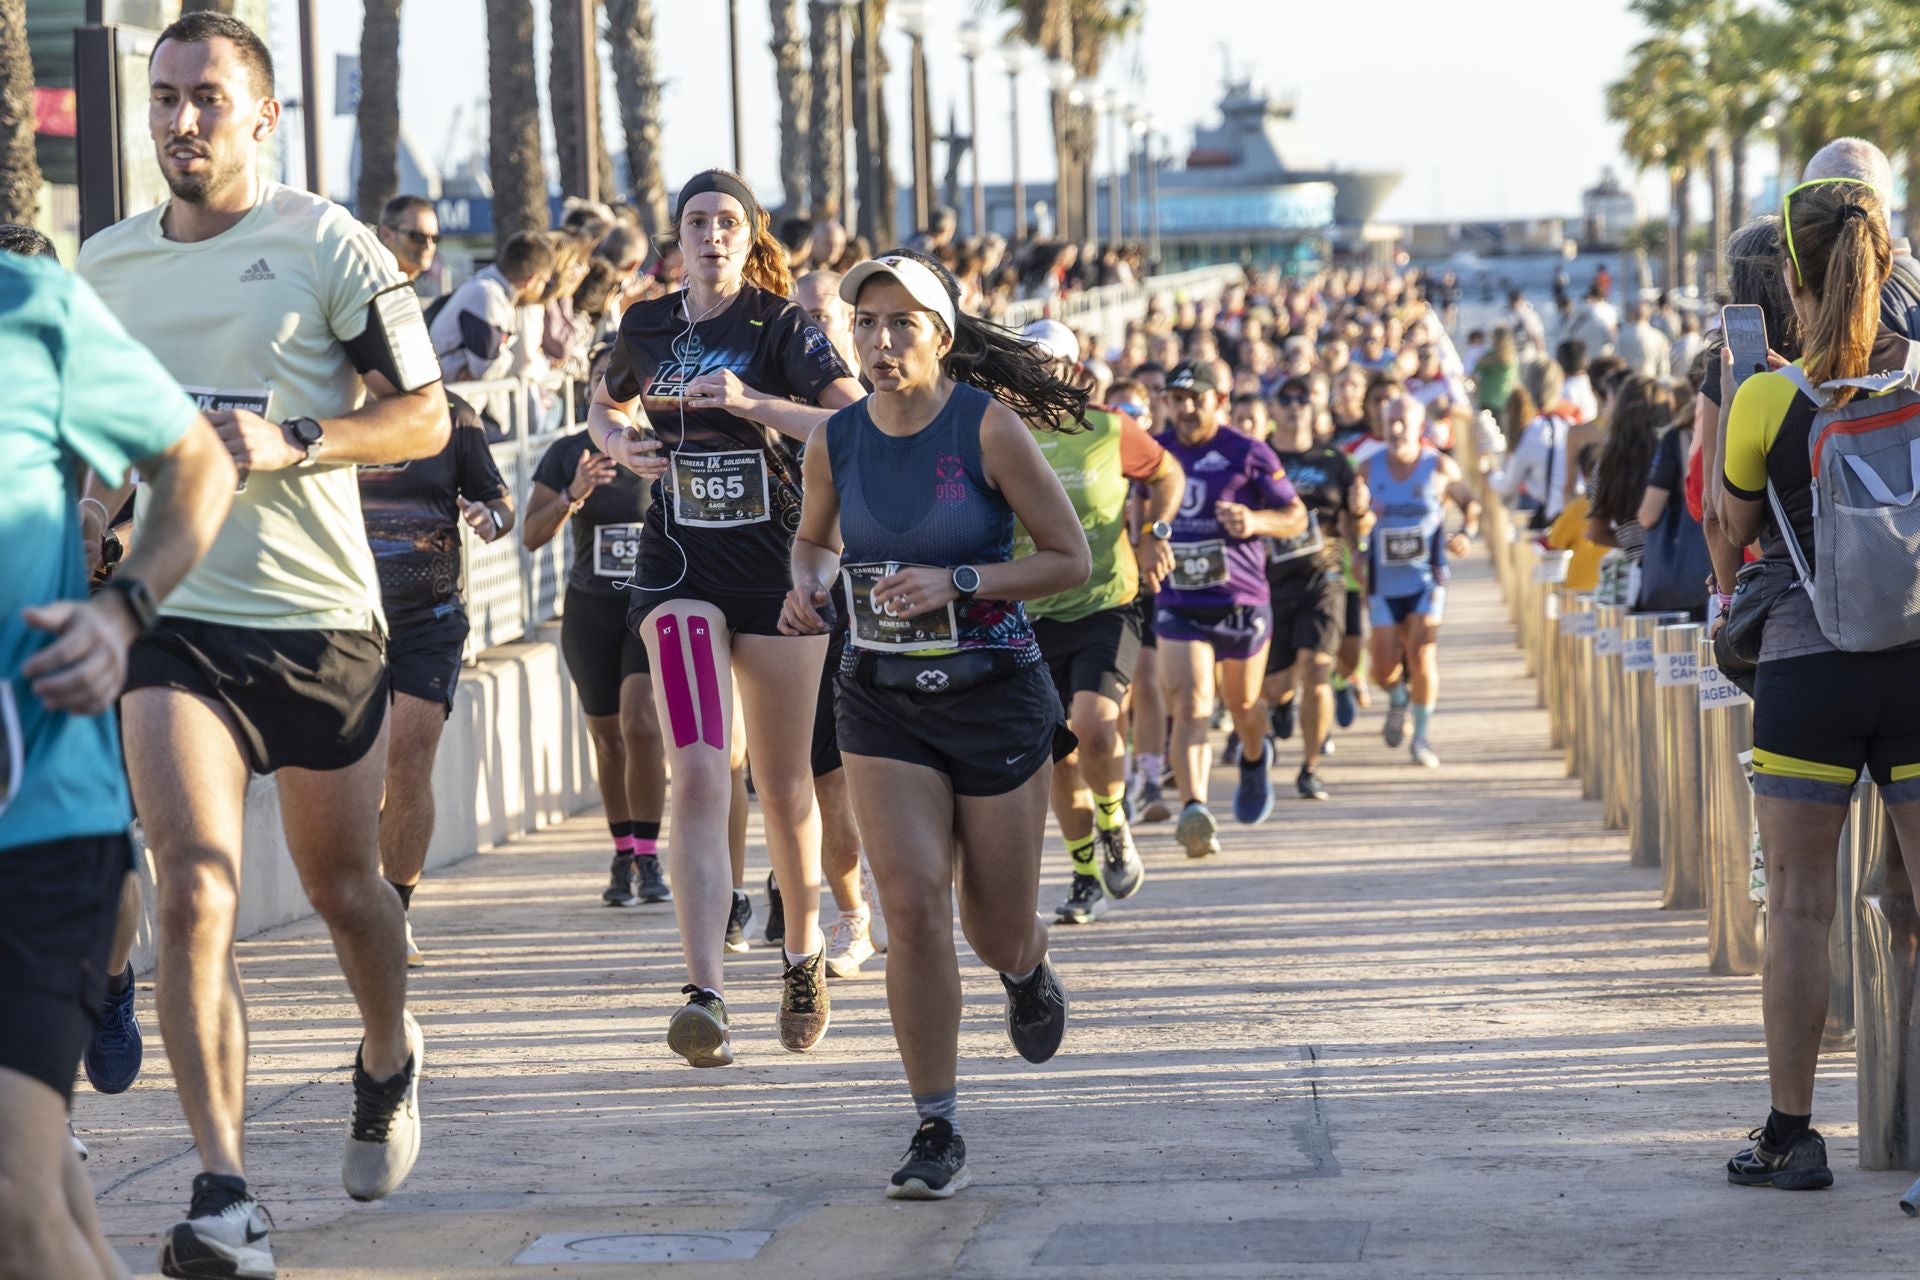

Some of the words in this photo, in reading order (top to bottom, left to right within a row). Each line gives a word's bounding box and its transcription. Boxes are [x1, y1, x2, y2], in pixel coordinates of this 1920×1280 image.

[240, 273, 275, 282] adidas
[680, 459, 705, 467] CARRERA
[707, 456, 721, 469] IX
[724, 458, 756, 466] SOLIDARIA
[690, 475, 745, 500] 665
[936, 483, 966, 499] OTSO
[663, 626, 671, 635] KT
[1700, 685, 1745, 701] AGEN
